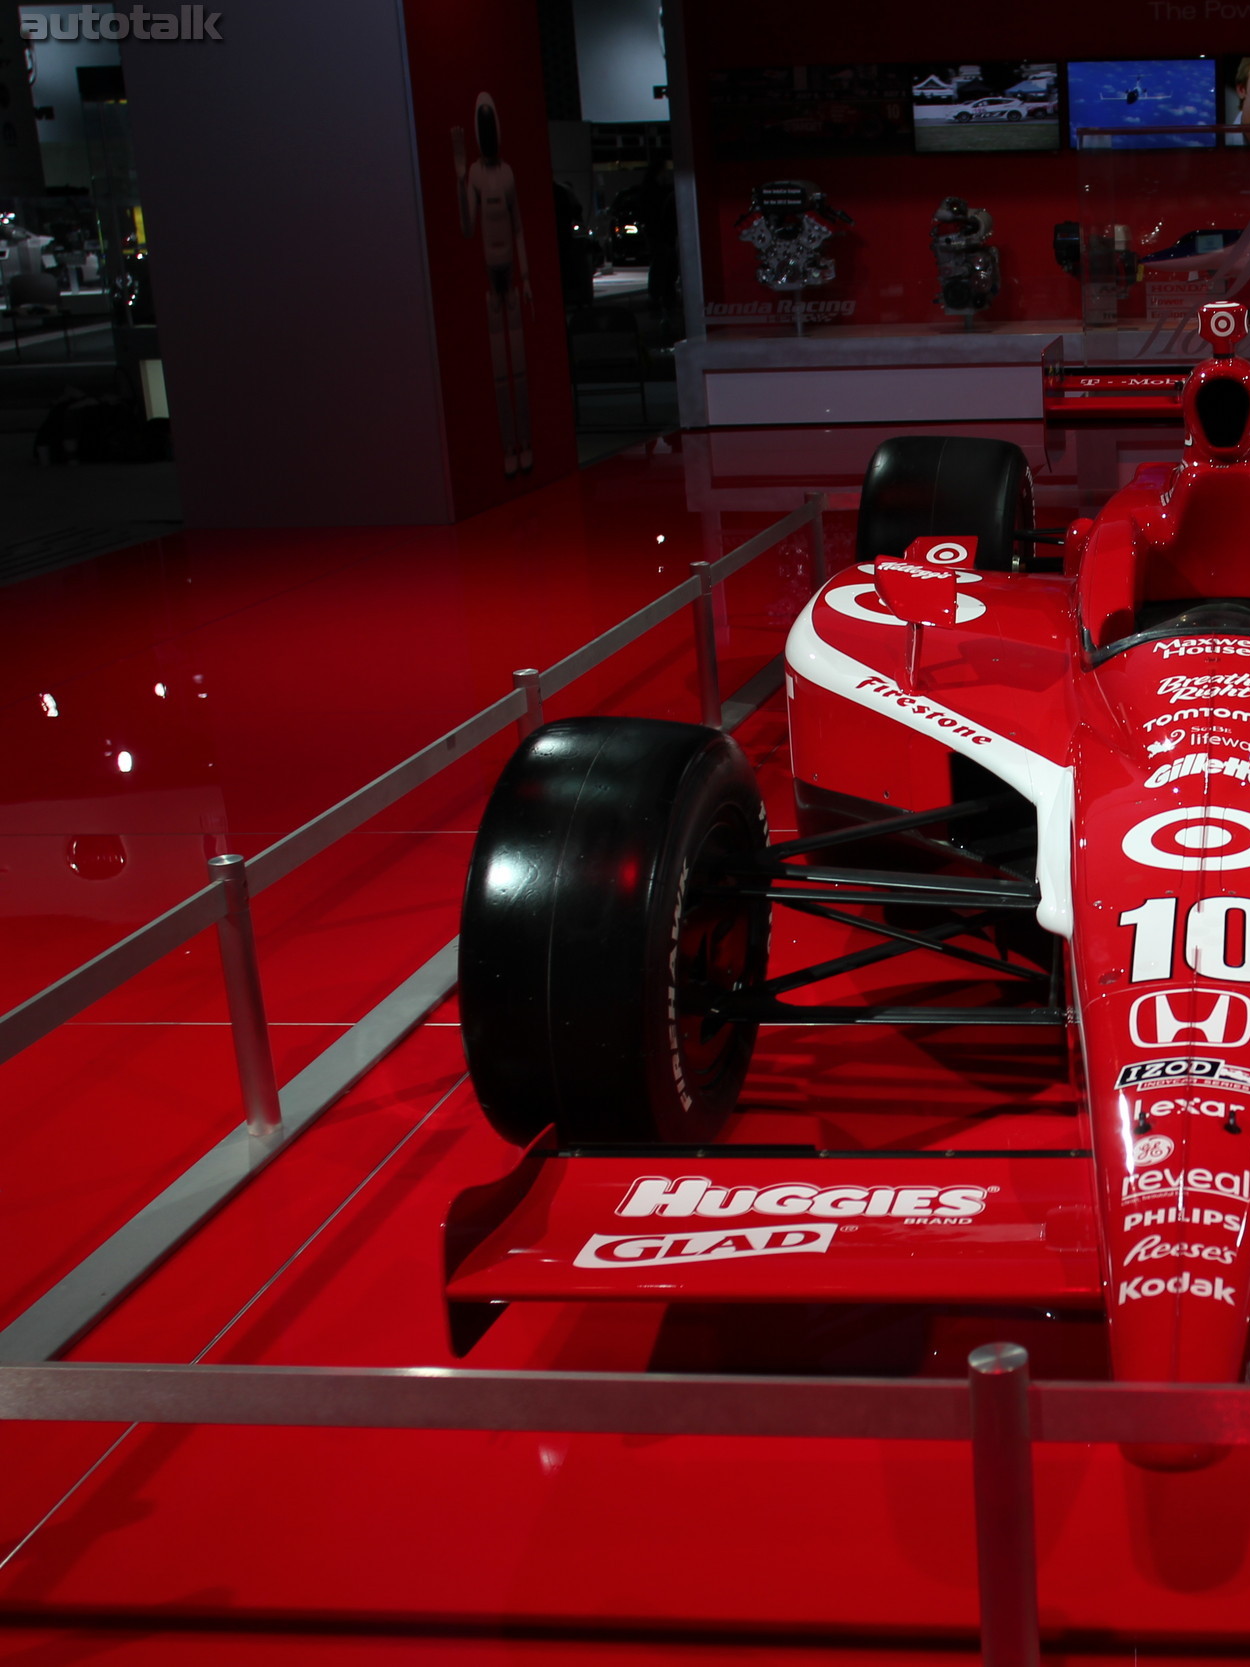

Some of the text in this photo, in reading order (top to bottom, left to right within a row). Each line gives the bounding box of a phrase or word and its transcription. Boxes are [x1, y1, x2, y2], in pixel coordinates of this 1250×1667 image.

[1152, 0, 1197, 21] The
[776, 300, 857, 316] Racing
[877, 561, 952, 580] Kellogg's
[855, 675, 993, 746] Firestone
[1125, 1060, 1213, 1082] IZOD
[1143, 1077, 1199, 1088] INDYCAR
[1134, 1097, 1246, 1121] Lexar
[1121, 1168, 1250, 1199] reveal
[903, 1217, 973, 1225] BRAND
[1123, 1207, 1241, 1232] PHILIPS
[594, 1230, 822, 1263] GLAD
[1122, 1233, 1240, 1267] Reese's
[1118, 1271, 1236, 1307] Kodak
